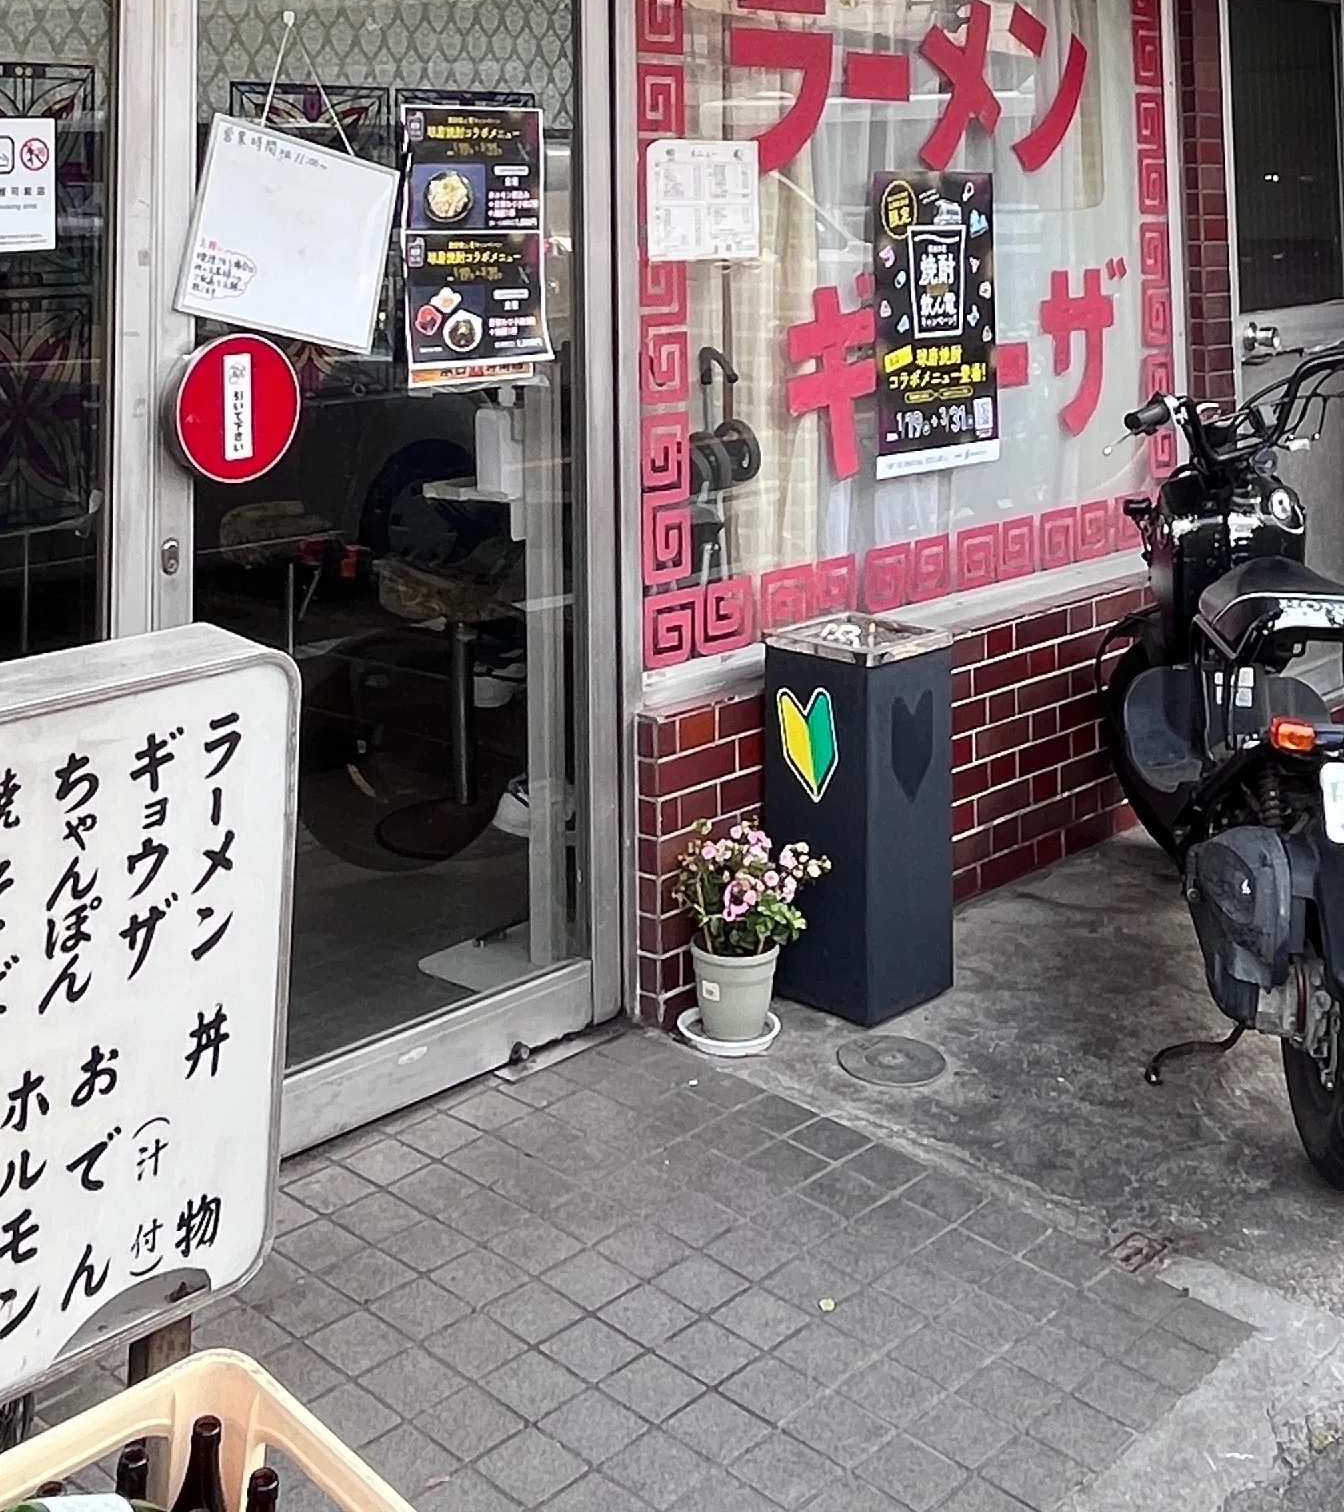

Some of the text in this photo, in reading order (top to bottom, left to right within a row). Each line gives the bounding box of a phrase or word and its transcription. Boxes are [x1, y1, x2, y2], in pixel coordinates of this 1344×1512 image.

[38, 752, 102, 1016] ちゃんぽん
[118, 726, 185, 981] ギョウザ
[190, 712, 242, 963] ラーメン
[60, 1045, 122, 1313] おでん
